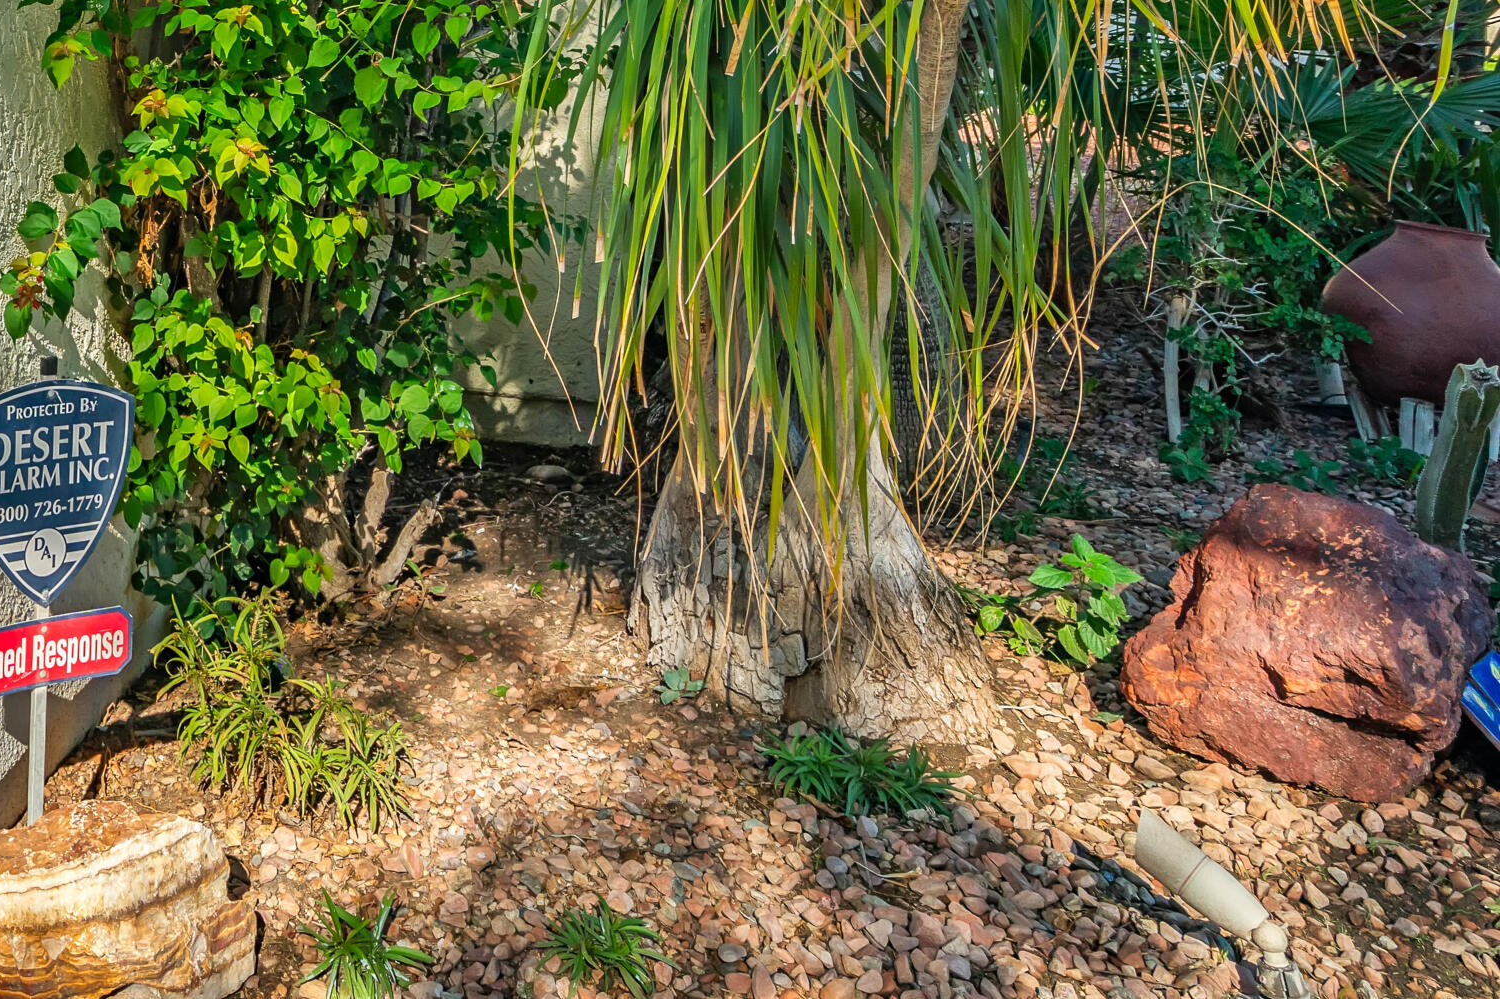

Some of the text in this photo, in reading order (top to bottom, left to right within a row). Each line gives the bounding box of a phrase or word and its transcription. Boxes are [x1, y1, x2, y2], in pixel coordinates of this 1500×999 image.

[68, 457, 115, 484] INC.
[34, 493, 103, 518] 726-1779
[35, 628, 124, 673] Response
